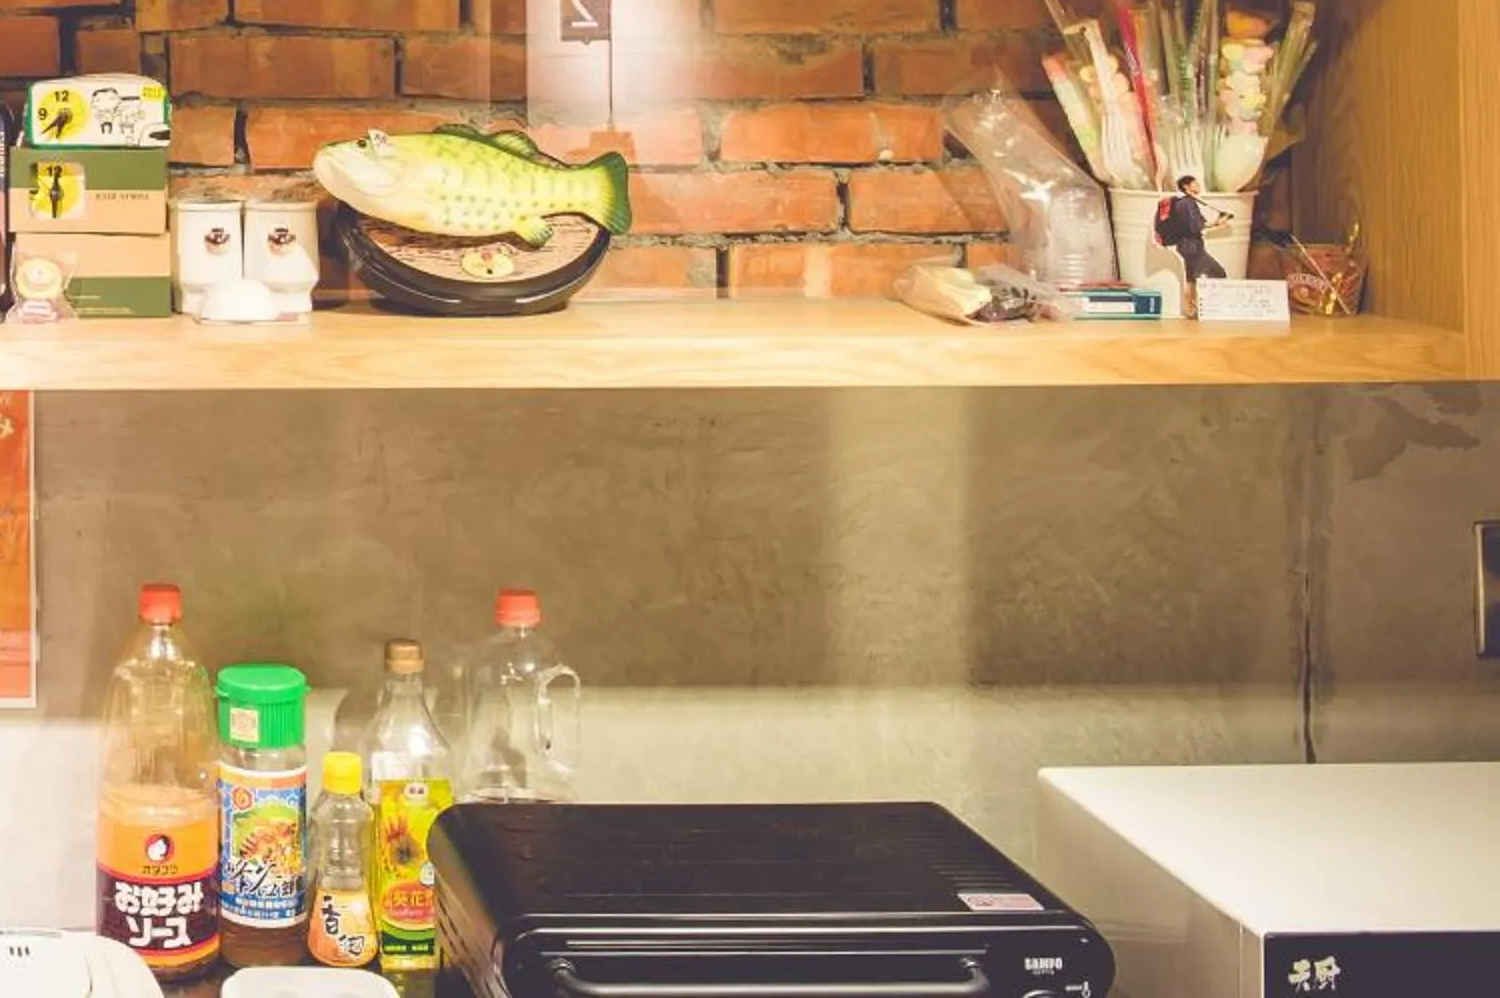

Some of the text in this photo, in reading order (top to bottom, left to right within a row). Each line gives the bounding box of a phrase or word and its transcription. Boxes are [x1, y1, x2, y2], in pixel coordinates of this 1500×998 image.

[54, 89, 70, 103] 12
[38, 107, 48, 121] 9
[142, 864, 179, 875] オタフク
[115, 881, 205, 917] お好み
[126, 915, 193, 949] ソース
[1024, 957, 1064, 971] SAMPO
